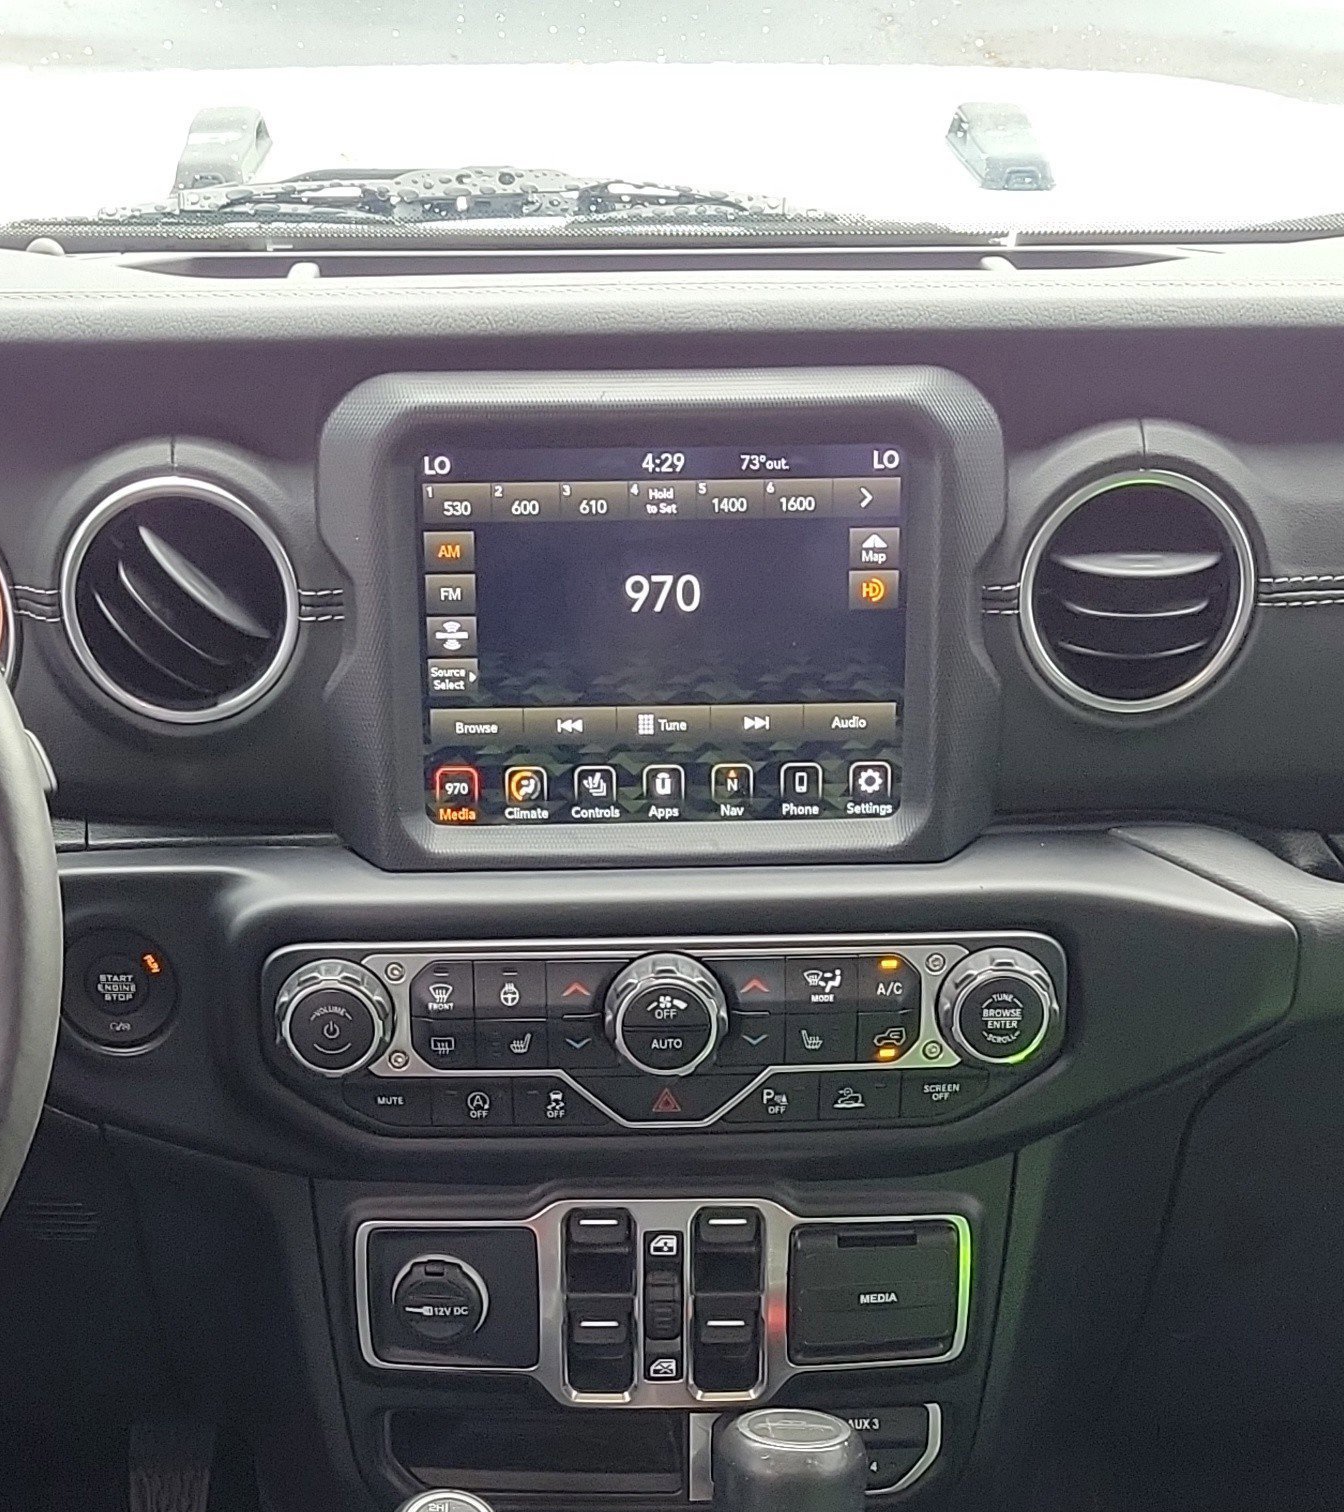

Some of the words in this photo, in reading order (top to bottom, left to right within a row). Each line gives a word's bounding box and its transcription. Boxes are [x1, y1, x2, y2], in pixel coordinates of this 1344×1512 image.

[424, 456, 451, 475] LO
[642, 453, 685, 473] 4:29
[873, 450, 900, 469] LO
[426, 486, 433, 498] 1
[494, 485, 503, 498] 2
[562, 485, 570, 497] 3
[630, 484, 639, 496] 4
[648, 488, 674, 500] Hold
[699, 483, 707, 495] 5
[766, 482, 775, 494] 6
[443, 501, 471, 516] 530
[511, 500, 539, 515] 600
[579, 500, 607, 515] 610
[646, 503, 658, 515] to
[660, 502, 677, 515] Set
[712, 497, 747, 513] 1400
[780, 496, 816, 512] 1600
[438, 545, 461, 558] AM
[861, 550, 886, 564] Map
[441, 588, 461, 601] FM
[625, 574, 701, 613] 970
[431, 666, 465, 678] Source
[434, 679, 464, 692] Select
[456, 721, 498, 734] Browse
[658, 718, 688, 732] Tune
[831, 715, 867, 729] Audio
[445, 781, 469, 796] 970
[440, 807, 476, 821] Media
[505, 806, 549, 820] Climate
[571, 805, 620, 819] Controls
[649, 805, 679, 820] Apps
[720, 804, 744, 817] Nav
[782, 803, 819, 816] Phone
[847, 801, 892, 817] Settings
[99, 974, 134, 982] START
[97, 983, 136, 992] ENGINE
[877, 982, 902, 995] A/C
[104, 993, 133, 1001] STOP
[811, 994, 835, 1003] MODE
[991, 993, 1014, 1002] TUNE
[315, 1005, 347, 1017] VOLUME
[428, 1002, 454, 1011] FRONT
[982, 1008, 1022, 1017] BROWSE
[654, 1009, 677, 1019] OFF
[987, 1020, 1018, 1029] ENTER
[651, 1038, 683, 1049] AUTO
[986, 1033, 1017, 1043] SCROLL
[924, 1083, 960, 1093] SCREEN
[377, 1096, 404, 1105] MUTE
[932, 1092, 950, 1101] OFF
[470, 1109, 488, 1118] OFF
[547, 1109, 565, 1118] OFF
[768, 1105, 786, 1114] OFF
[860, 1292, 898, 1305] MEDIA
[434, 1307, 452, 1316] 12V
[454, 1306, 469, 1315] DC
[872, 1418, 880, 1429] 3
[428, 1503, 444, 1512] 2H
